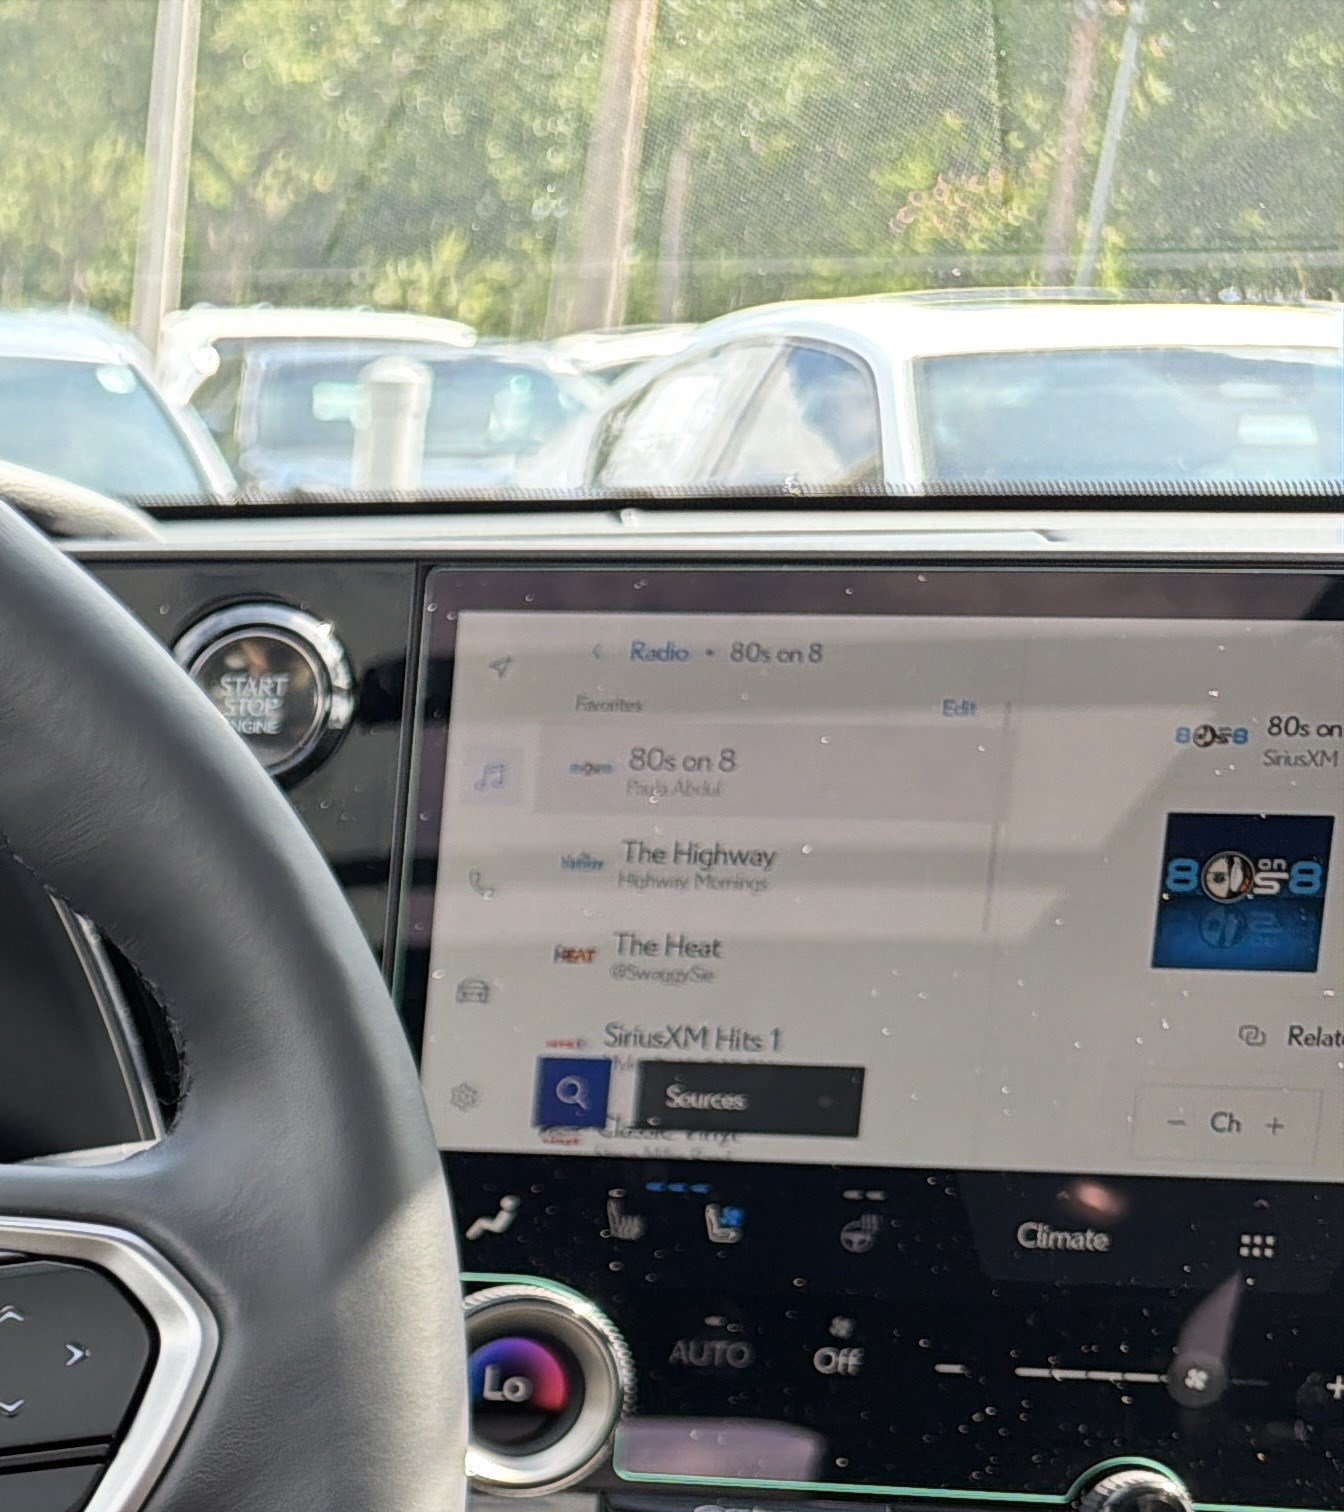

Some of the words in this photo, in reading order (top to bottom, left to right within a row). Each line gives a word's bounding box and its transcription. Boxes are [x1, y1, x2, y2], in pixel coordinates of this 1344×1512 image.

[630, 641, 690, 663] Radio
[729, 641, 771, 664] 80s
[776, 647, 805, 664] on
[808, 642, 824, 664] 8
[220, 673, 290, 696] START
[223, 696, 284, 717] STOP
[575, 694, 645, 714] Favorites
[942, 699, 978, 717] Edit
[229, 718, 282, 735] NGINE
[1267, 715, 1311, 738] 80s
[1316, 723, 1343, 738] on
[629, 746, 676, 772] 80s
[682, 752, 709, 772] on
[717, 747, 737, 773] 8
[1263, 748, 1339, 768] SiriusXM
[622, 838, 667, 864] The
[673, 839, 778, 871] Highway
[612, 930, 659, 957] The
[664, 931, 723, 959] Heat
[603, 1022, 710, 1051] SiriusXM
[715, 1026, 763, 1052] Hits
[769, 1028, 782, 1053] 1
[1287, 1024, 1344, 1048] Relat
[665, 1084, 749, 1111] Sources
[1211, 1110, 1242, 1134] Ch
[1016, 1220, 1110, 1252] Climate
[669, 1338, 757, 1369] AUTO
[813, 1346, 865, 1376] Off
[484, 1365, 533, 1402] Lo
